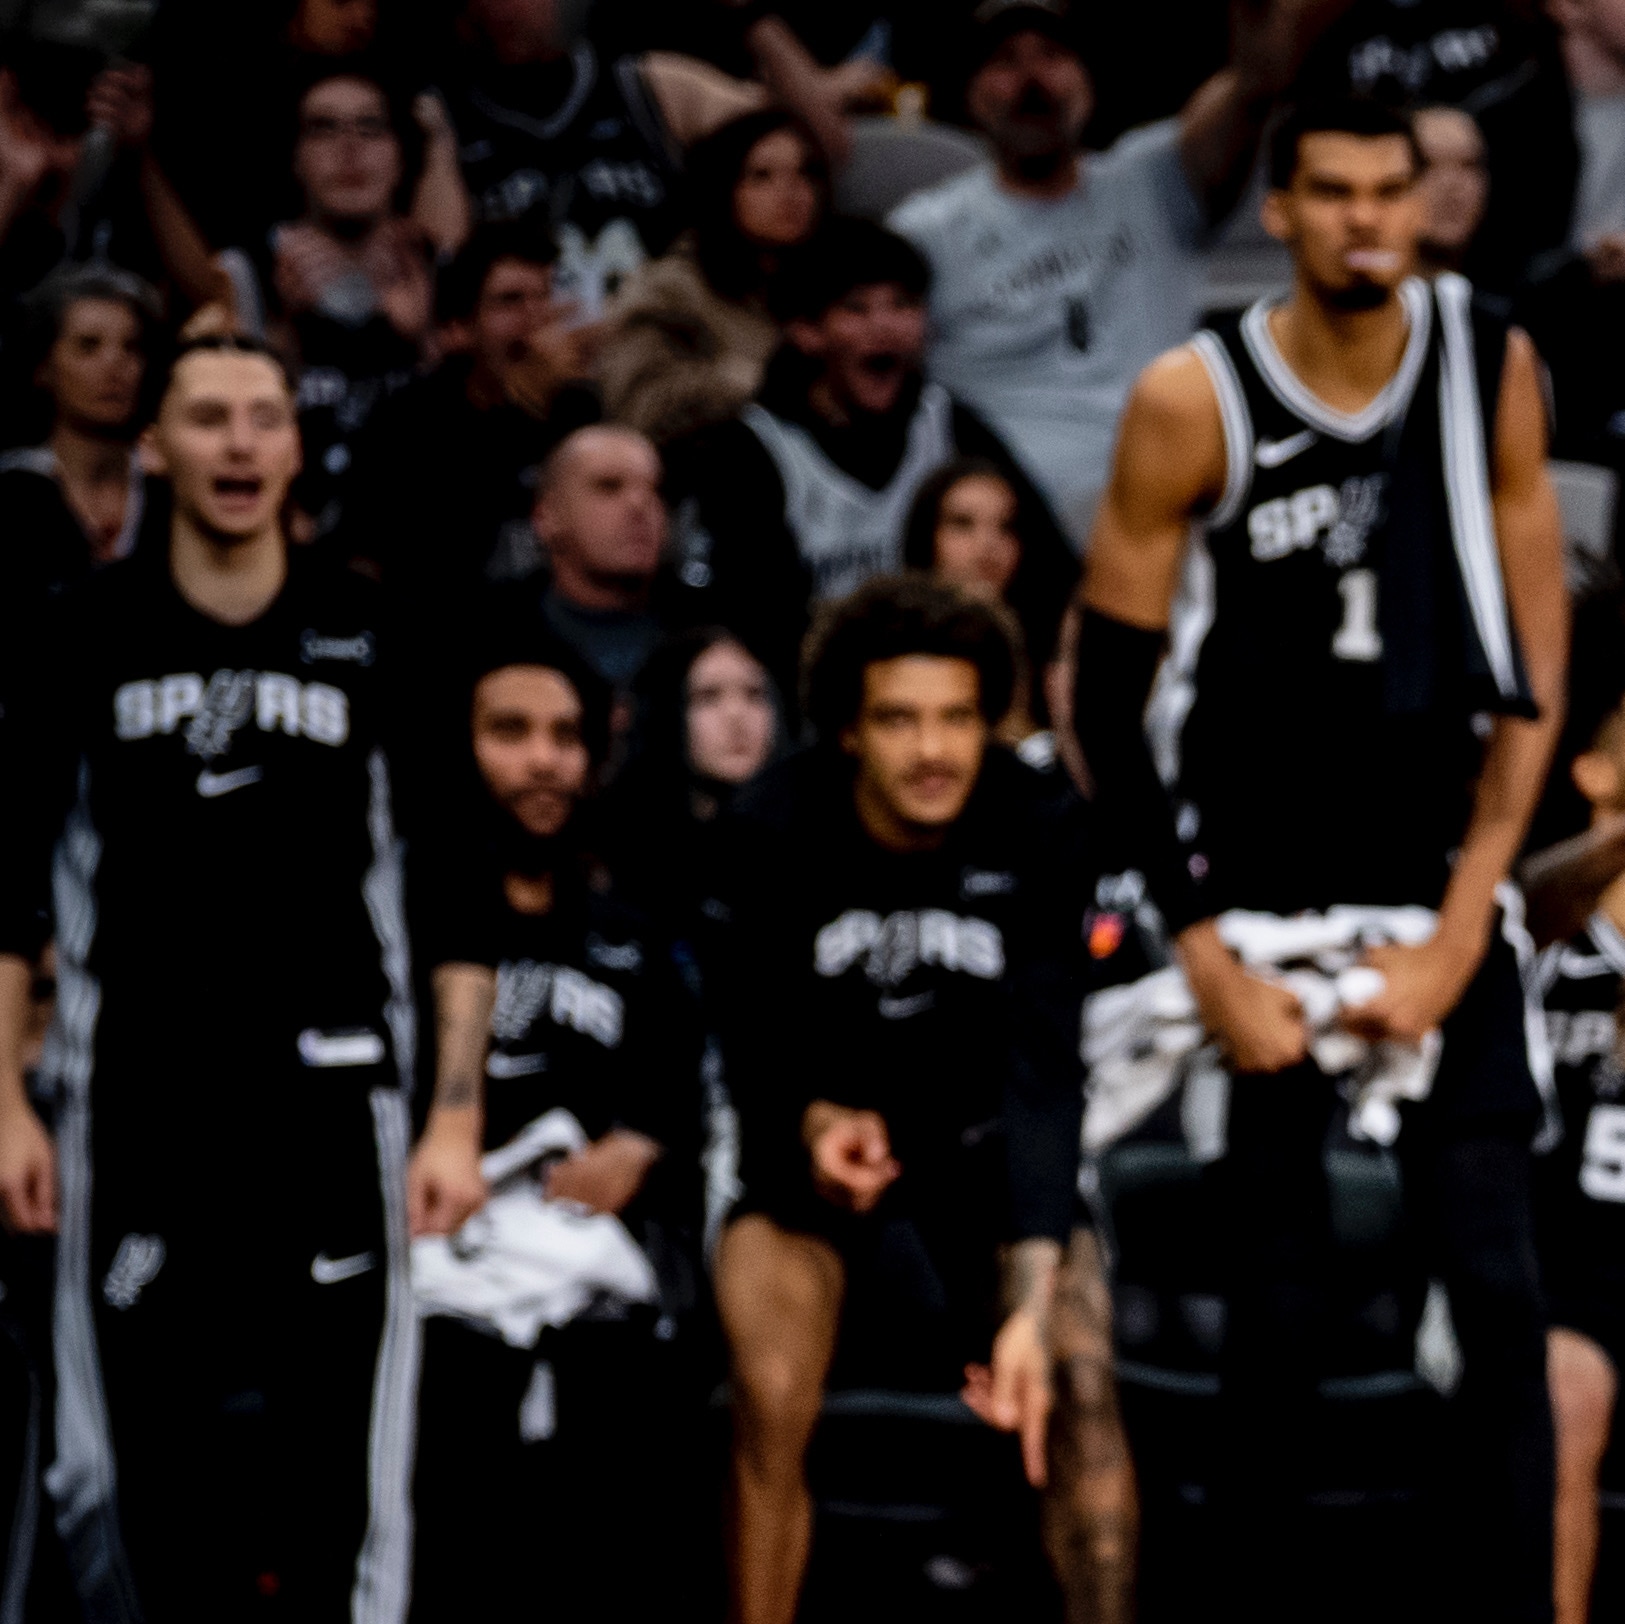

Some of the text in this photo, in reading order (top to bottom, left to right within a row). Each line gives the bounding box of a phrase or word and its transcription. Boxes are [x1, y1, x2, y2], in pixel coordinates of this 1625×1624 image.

[1331, 567, 1384, 662] 1
[114, 668, 351, 757] SPURS
[813, 908, 1005, 985] SPURS
